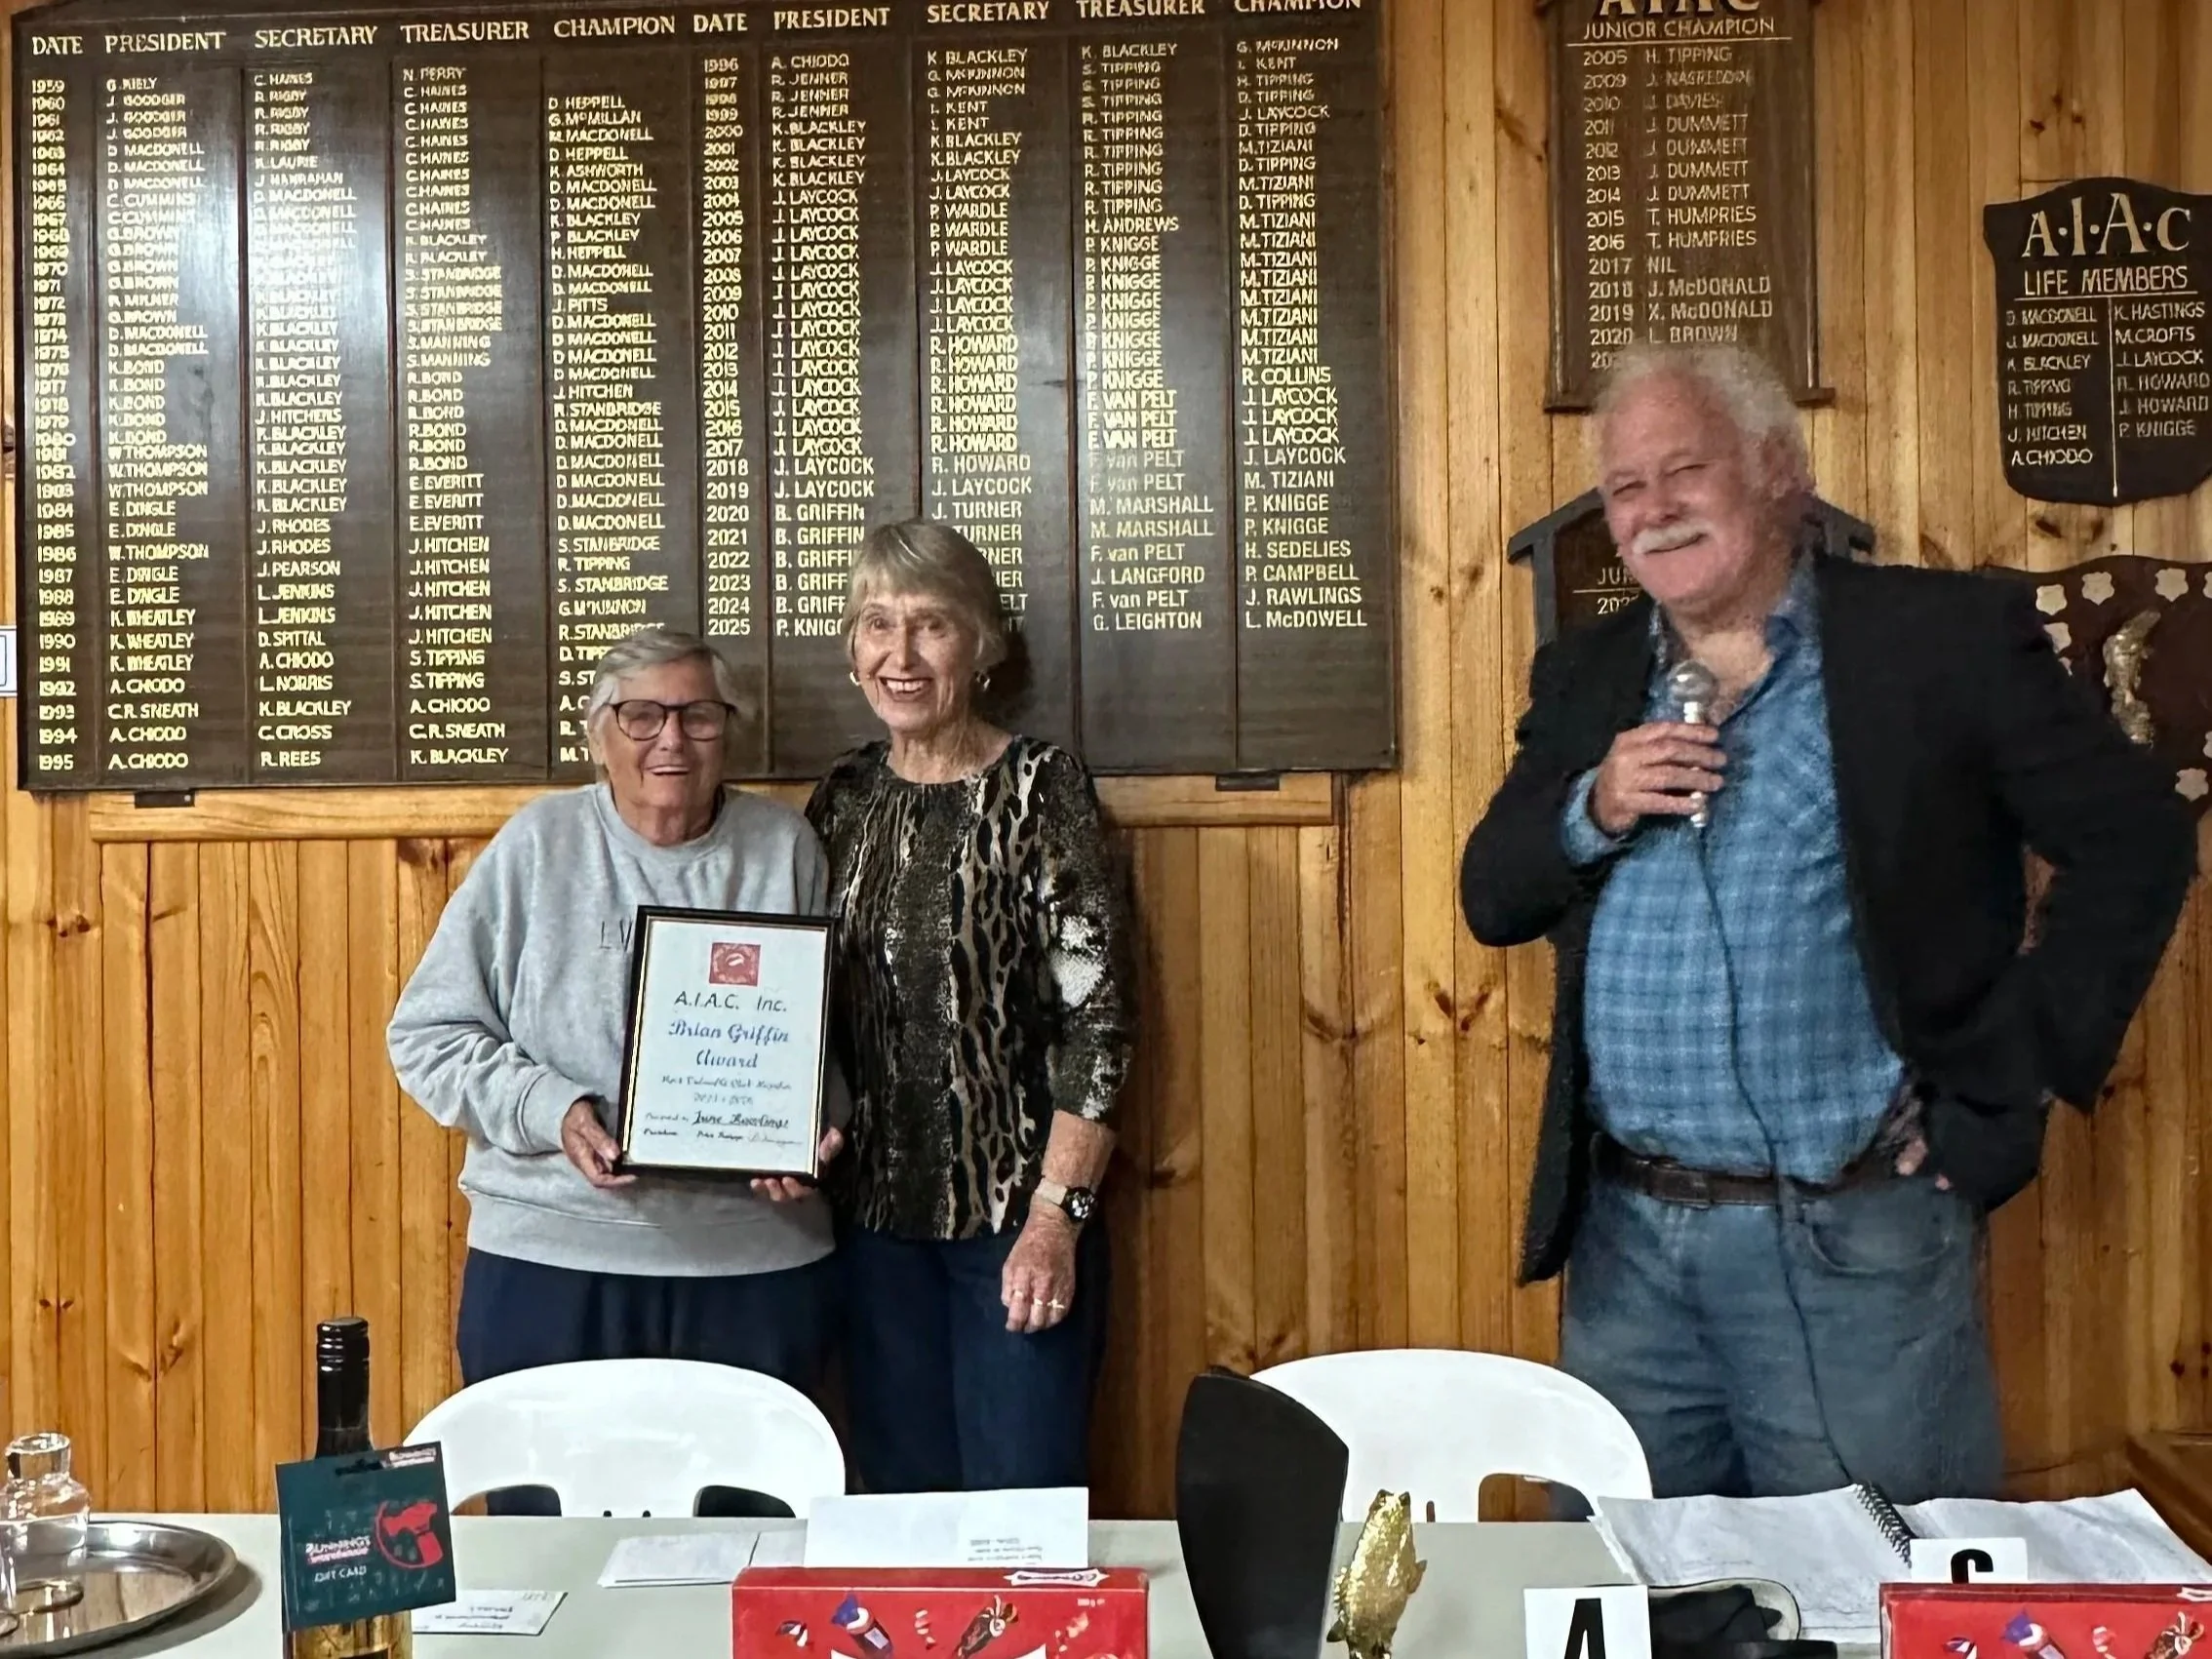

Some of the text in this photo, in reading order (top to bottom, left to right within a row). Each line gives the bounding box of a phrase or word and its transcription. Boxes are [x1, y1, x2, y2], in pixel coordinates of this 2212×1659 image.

[32, 36, 83, 55] DATE
[105, 31, 226, 53] PRESIDENT
[255, 25, 378, 50] SECRETARY
[400, 21, 530, 43] TREASURER
[553, 16, 675, 38] CHAMPION
[693, 12, 748, 33] DATE
[774, 8, 890, 30] PRESIDENT
[928, 1, 1049, 23] SECRETARY
[1079, 0, 1205, 18] TREASURER
[1584, 17, 1774, 40] JUNIOR CHAMPION
[946, 48, 1027, 64] BLACKLEY
[1583, 51, 1628, 66] 2005
[1669, 47, 1732, 62] TIPPING
[420, 66, 467, 80] PERRY
[566, 96, 625, 109] HEPPELL
[1257, 156, 1316, 172] TIPPING
[1586, 161, 1748, 181] 2013 J. DUMMETT
[566, 178, 656, 193] MACDONELL
[790, 189, 858, 204] LAYCOCK
[1103, 217, 1179, 233] ANDREWS
[1587, 206, 1756, 226] 2015 T. HUMPRIES
[702, 230, 742, 245] 2006
[945, 221, 1008, 237] WARDLE
[1589, 257, 1678, 275] 2017 NIL
[1649, 282, 1663, 297] J.
[1669, 276, 1771, 296] McDONALD
[2025, 265, 2188, 296] LIFE MEMBERS
[567, 297, 609, 312] PITTS
[1590, 305, 1633, 322] 2019
[1671, 300, 1772, 319] McDONALD
[2132, 301, 2205, 320] HASTINGS
[1591, 329, 1633, 345] 2020
[1671, 325, 1737, 342] BROWN
[2135, 349, 2203, 367] LAYCOCK
[1261, 367, 1331, 384] COLLINS
[1103, 390, 1136, 409] VAN
[1141, 389, 1176, 408] PELT
[2138, 396, 2208, 415] HOWARD
[932, 454, 1030, 475] R. HOWARD
[1244, 447, 1346, 466] J. LAYCOCK
[706, 459, 748, 476] 2018
[774, 457, 875, 476] J. LAYCOCK
[932, 477, 1032, 496] J. LAYCOCK
[1244, 470, 1334, 489] M. TIZIANI
[707, 482, 749, 499] 2019
[774, 481, 875, 499] J. LAYCOCK
[775, 503, 864, 522] B. GRIFFIN
[932, 501, 1022, 520] J. TURNER
[1090, 494, 1213, 516] M. MARSHALL
[1245, 494, 1328, 513] P. KNIGGE
[707, 505, 749, 522] 2020
[424, 536, 490, 553] HITCHEN
[708, 529, 747, 545] 2021
[776, 527, 864, 545] B. GRIFFIN
[37, 545, 77, 563] 1986
[1091, 543, 1185, 562] F. van PELT
[1245, 540, 1352, 559] H. SEDELIES
[271, 560, 340, 576] PEARSON
[574, 556, 631, 571] TIPPING
[708, 552, 750, 569] 2022
[38, 568, 73, 583] 1987
[1091, 566, 1205, 584] J. LANGFORD
[1245, 563, 1360, 582] P. CAMPBELL
[709, 574, 750, 592] 2023
[1092, 590, 1189, 609] F. van PELT
[1245, 586, 1363, 606] J. RAWLINGS
[709, 597, 750, 614] 2024
[709, 618, 750, 636] 2025
[1094, 612, 1202, 632] G. LEIGHTON
[1245, 611, 1367, 629] L. McDOWELL
[40, 634, 76, 650] 1990
[127, 632, 194, 649] WHEATLEY
[273, 631, 325, 647] SPITTAL
[276, 652, 334, 668] CHIODO
[39, 754, 73, 770] 1995
[430, 747, 509, 764] BLACKLEY
[757, 994, 787, 1012] Inc.
[668, 1020, 789, 1046] Brian Griffin
[696, 1049, 757, 1069] Award
[1564, 1598, 1606, 1659] A
